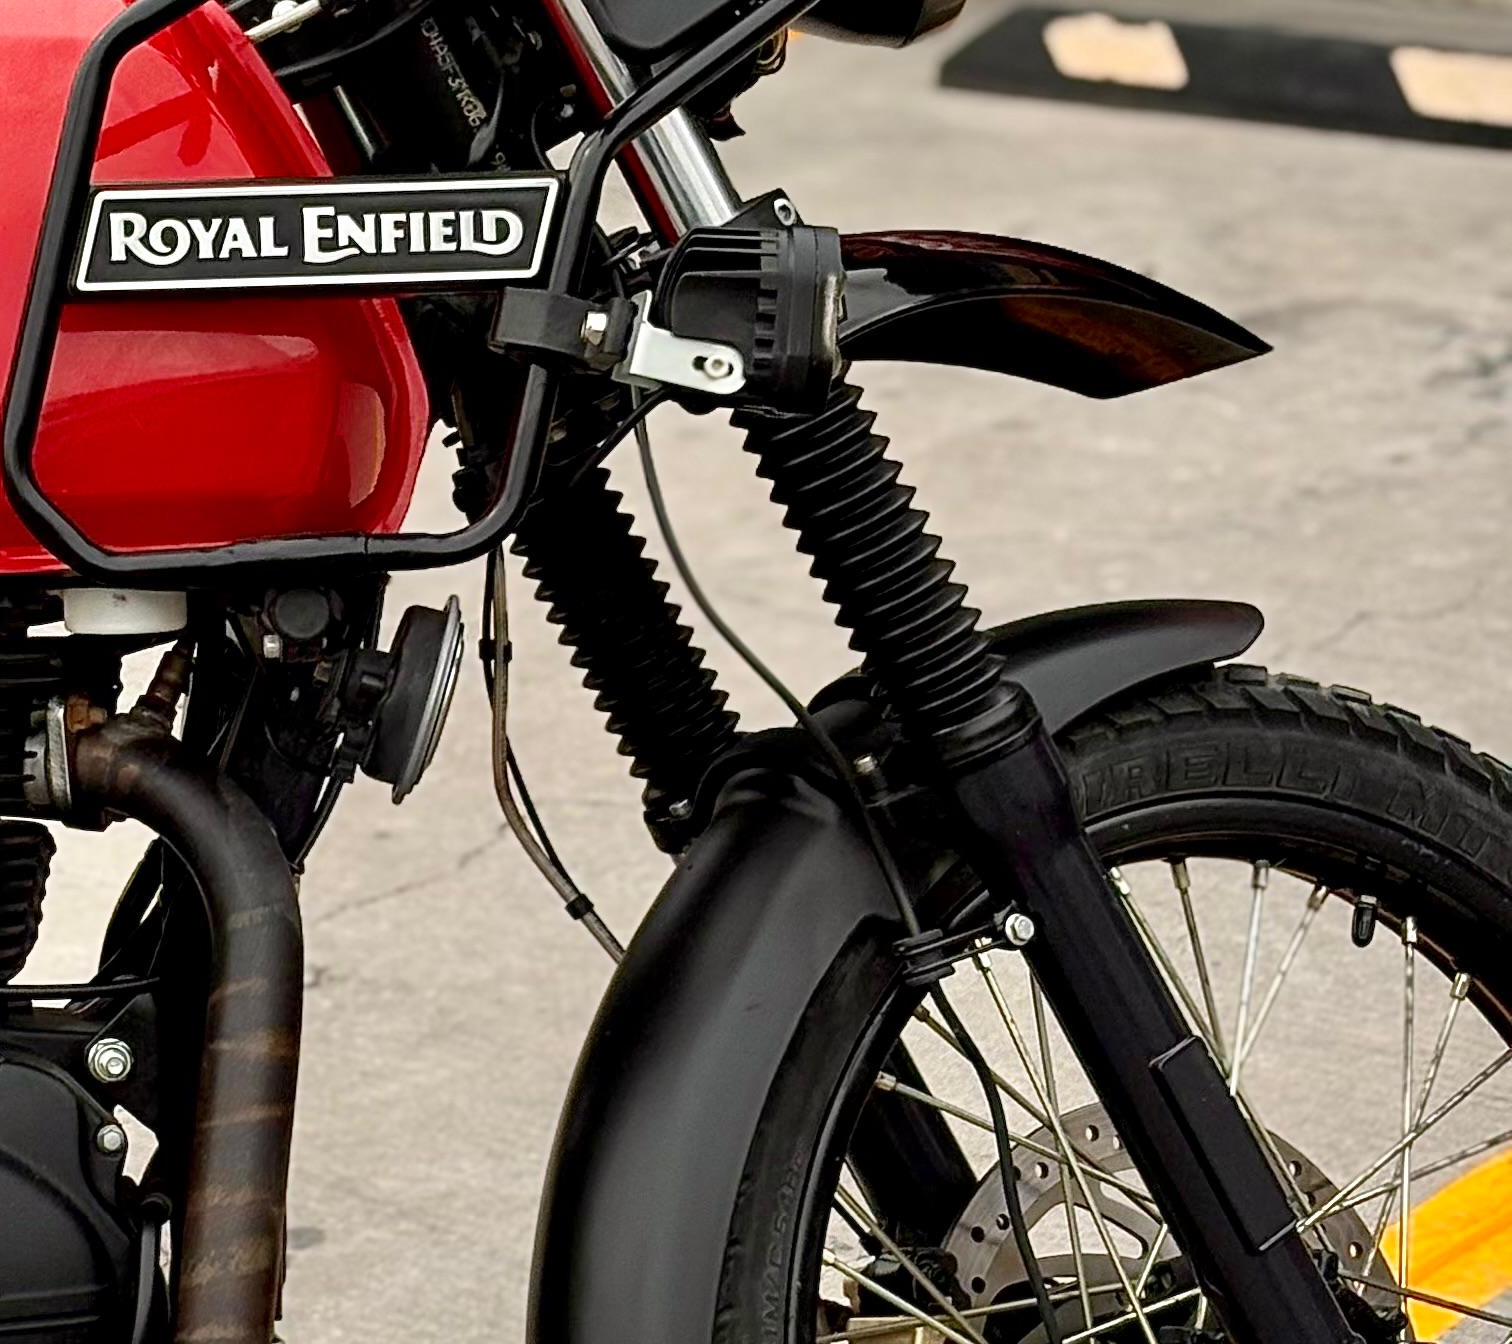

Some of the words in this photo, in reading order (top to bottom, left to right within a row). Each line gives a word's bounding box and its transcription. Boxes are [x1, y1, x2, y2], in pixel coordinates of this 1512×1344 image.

[109, 211, 288, 265] ROYAL
[302, 206, 524, 263] ENFIELD
[1072, 736, 1362, 819] IRELLI
